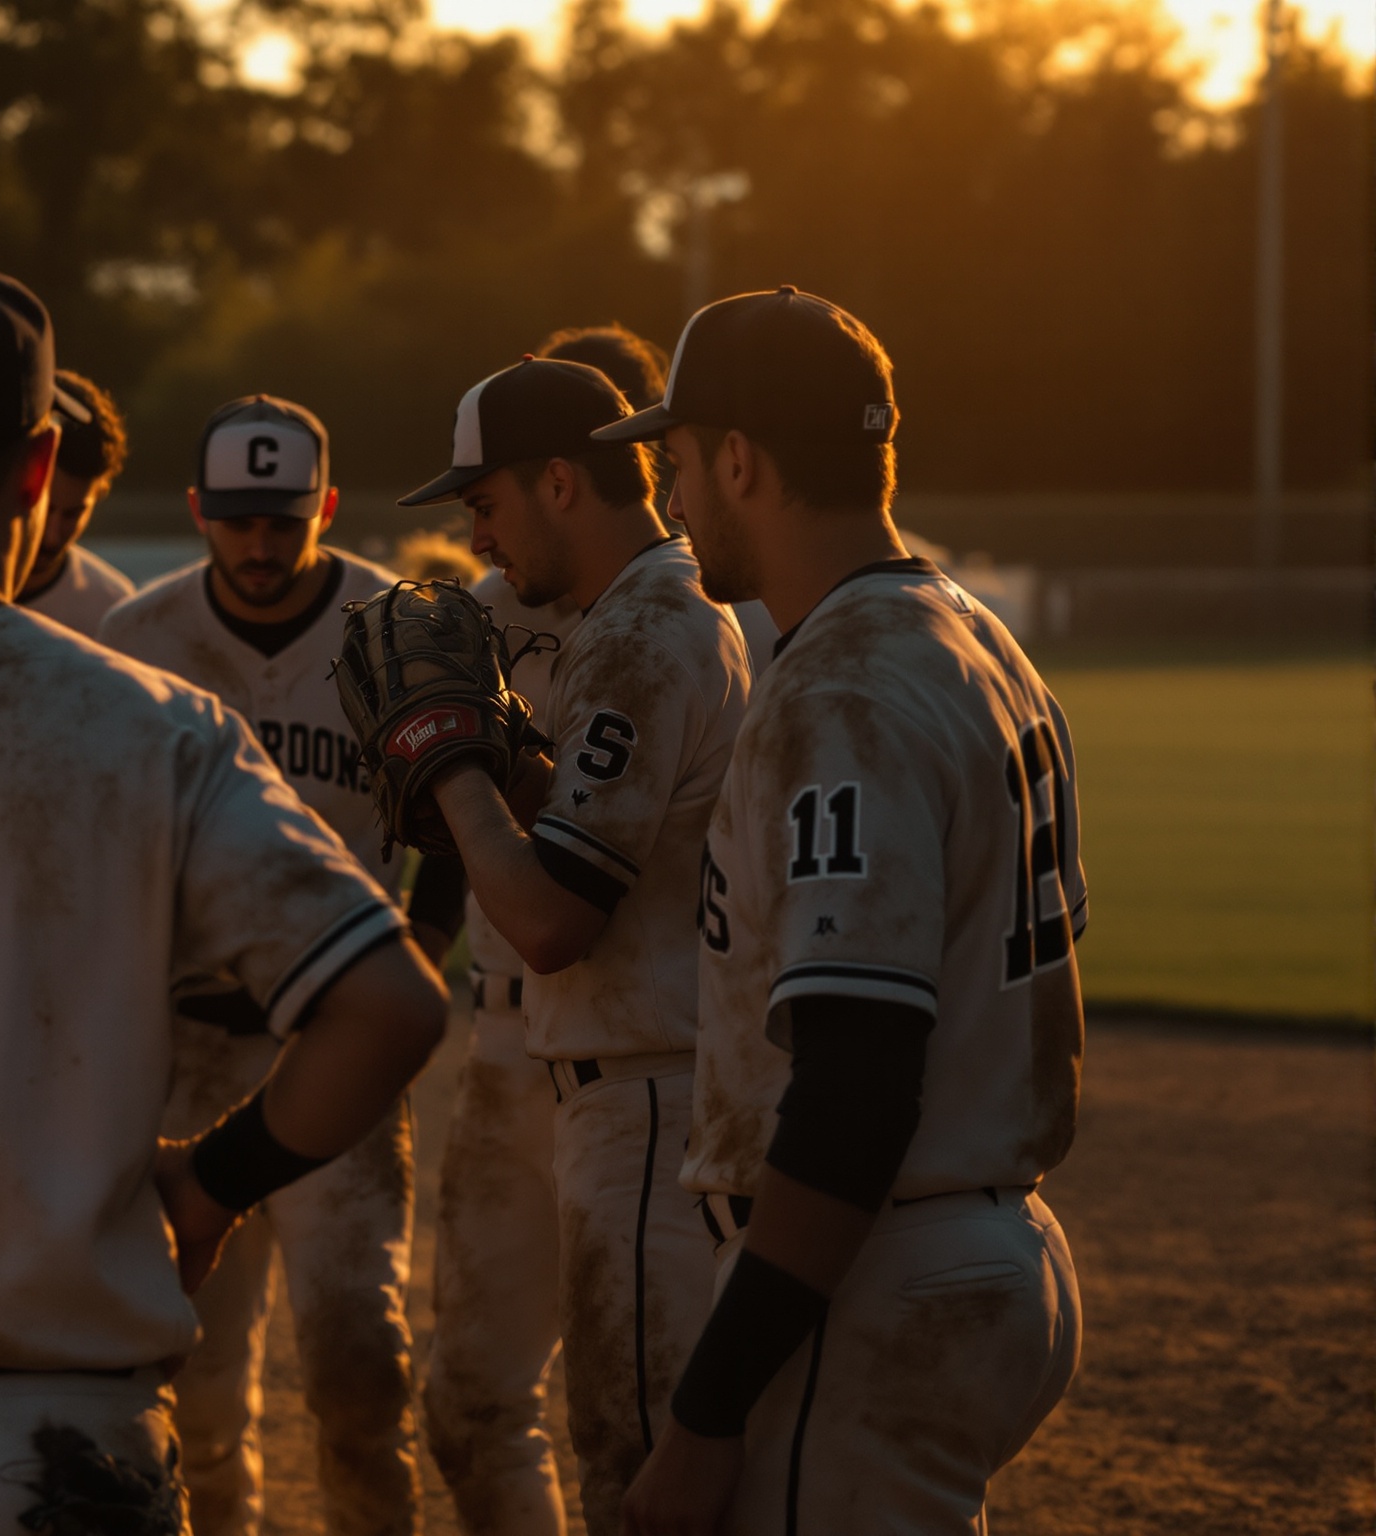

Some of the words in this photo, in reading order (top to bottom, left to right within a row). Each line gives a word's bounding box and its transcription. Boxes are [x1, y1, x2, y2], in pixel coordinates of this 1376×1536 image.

[248, 436, 278, 477] C
[575, 708, 638, 783] S
[788, 781, 868, 885] 11
